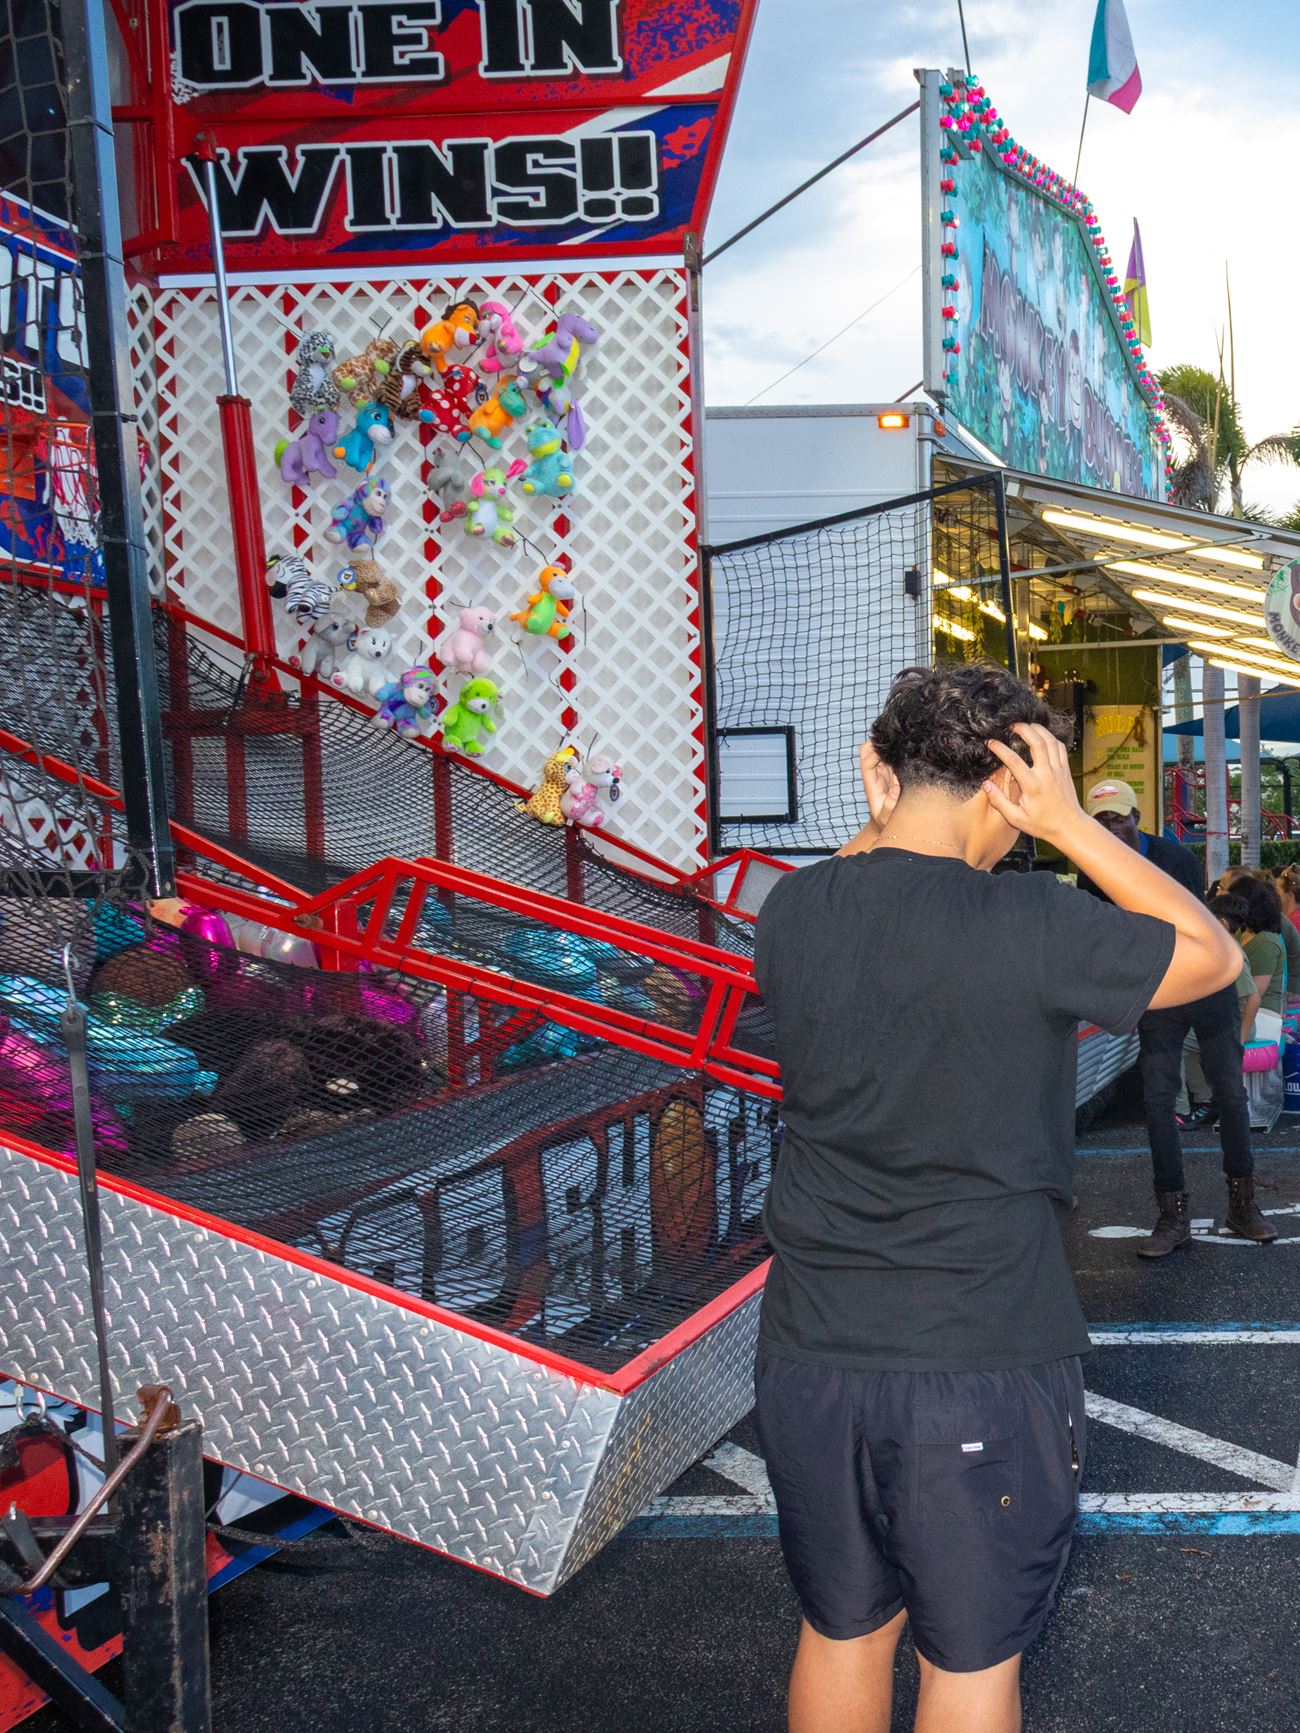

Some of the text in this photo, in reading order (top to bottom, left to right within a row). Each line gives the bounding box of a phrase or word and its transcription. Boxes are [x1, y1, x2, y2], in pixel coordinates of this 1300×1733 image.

[176, 0, 622, 89] ONE IN
[182, 131, 660, 237] WINS!!
